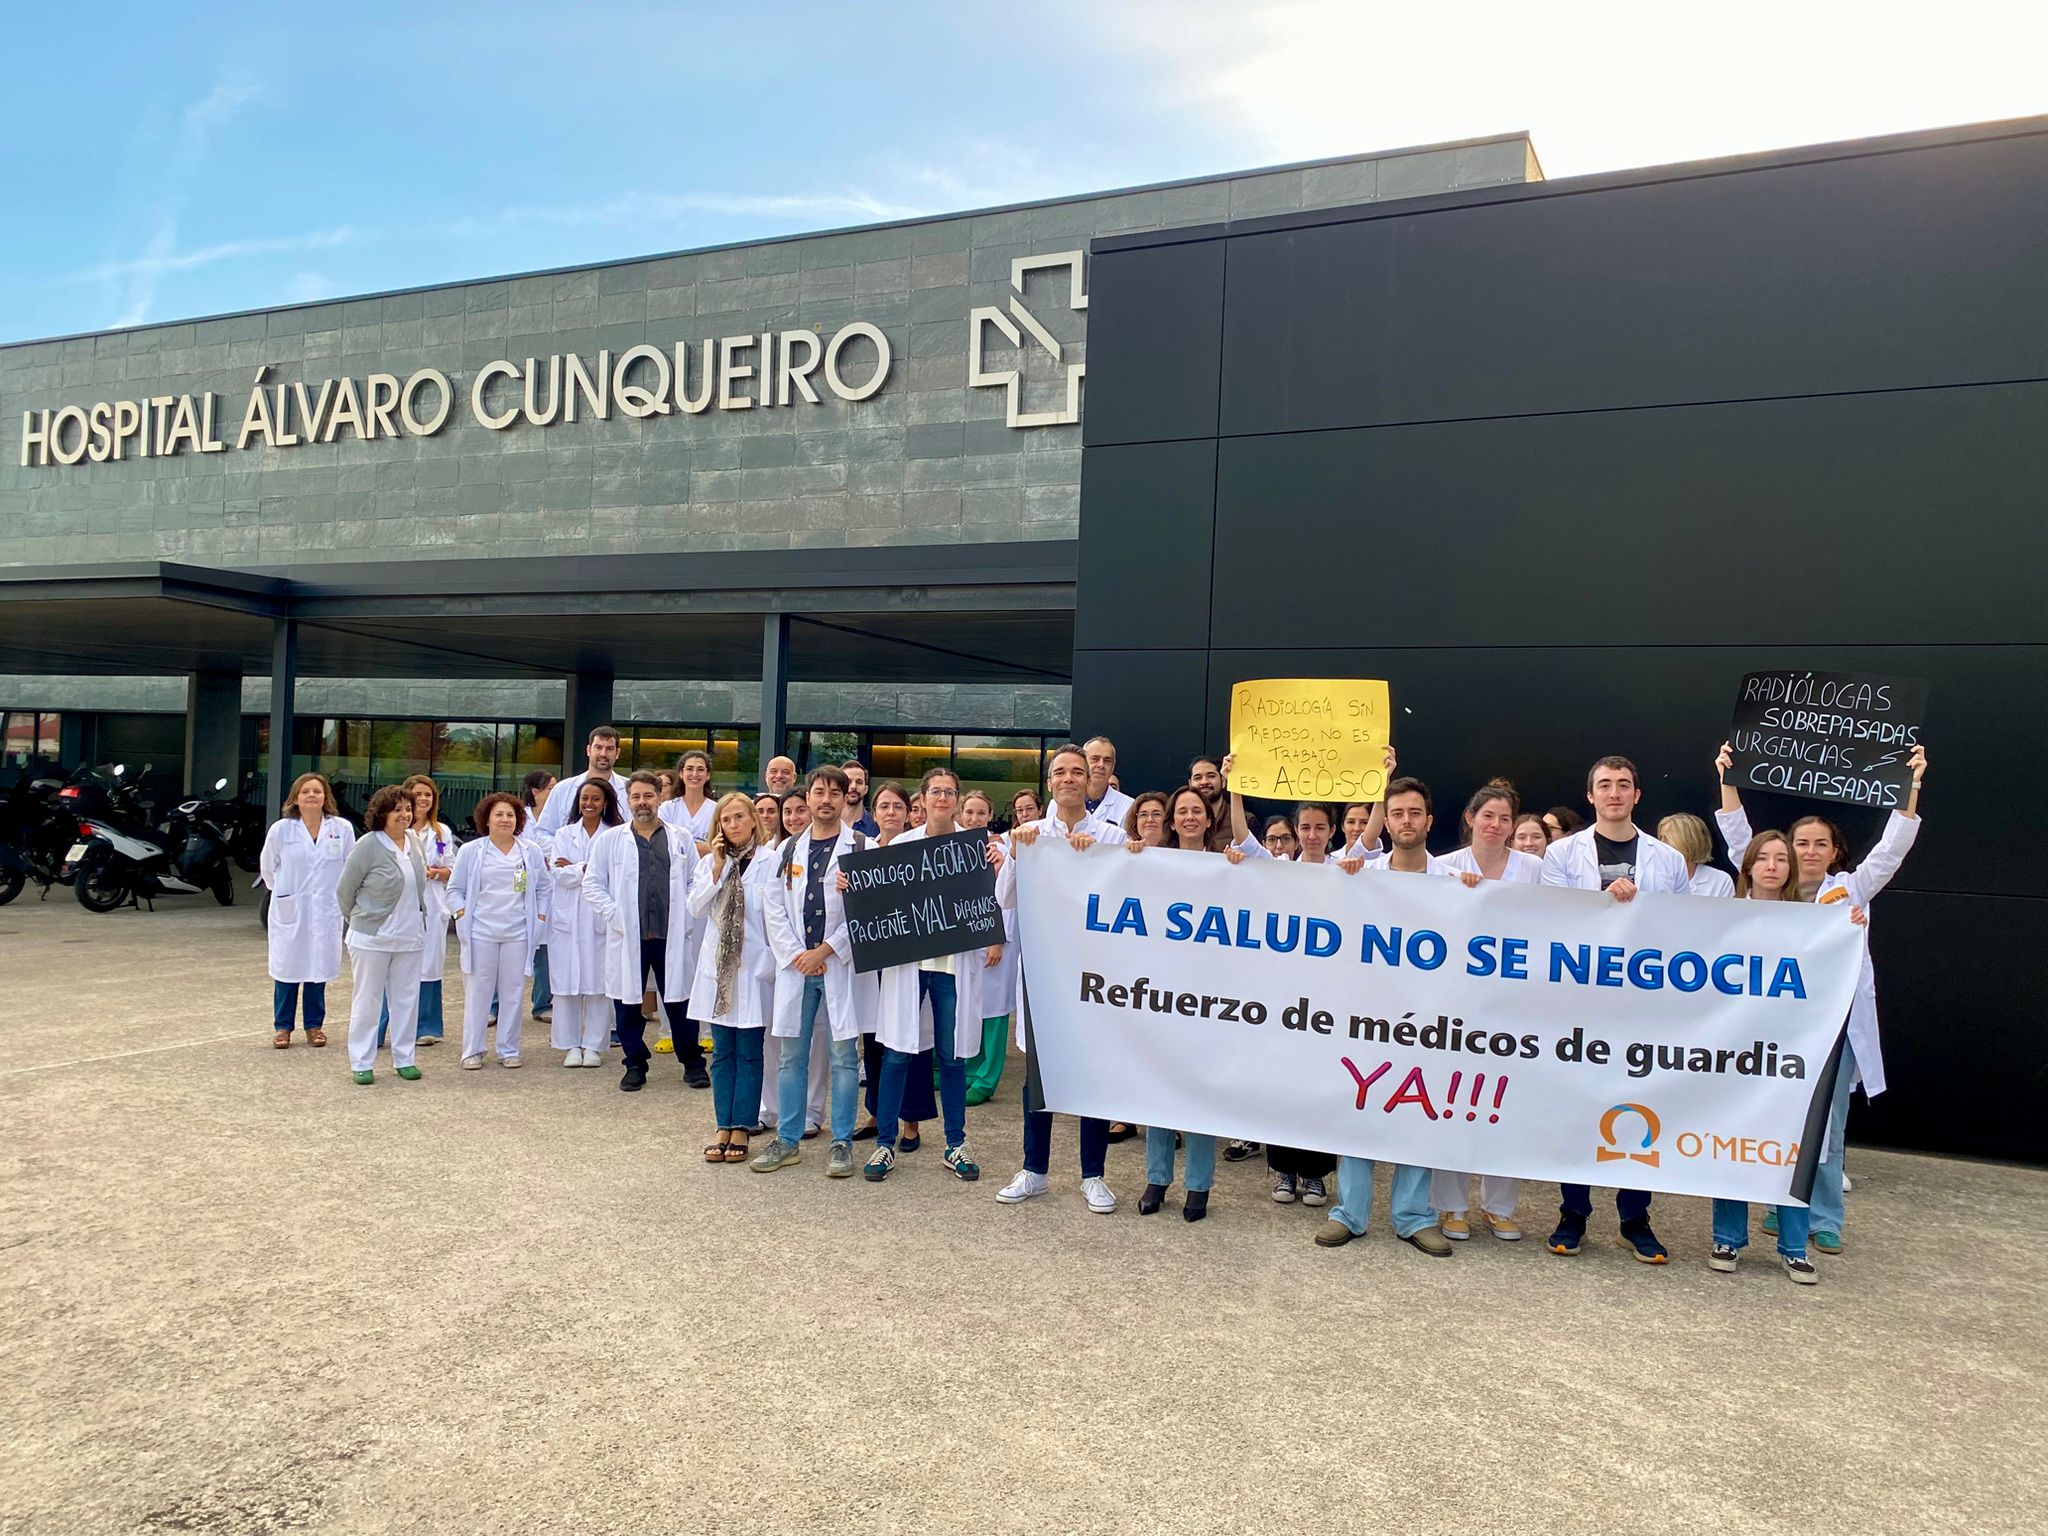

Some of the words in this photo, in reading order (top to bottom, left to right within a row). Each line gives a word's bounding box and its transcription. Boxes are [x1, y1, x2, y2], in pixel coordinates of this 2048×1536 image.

[20, 391, 227, 466] HOSPITAL
[236, 365, 454, 450] ÁLVARO
[471, 321, 892, 430] CUNQUEIRO
[1238, 689, 1334, 720] RADIOLOGÍA
[1348, 699, 1374, 717] SIN
[1744, 672, 1892, 711] RADIÓLOGAS
[1320, 728, 1342, 740] NO
[1352, 728, 1370, 743] ES
[1759, 707, 1919, 747] SOBREPASADAS
[1269, 745, 1342, 767] TRABAJO,
[1735, 729, 1856, 769] URGENCIAS
[1240, 776, 1260, 790] ES
[1750, 762, 1901, 806] COLAPSADAS
[920, 839, 987, 882] AGOTADO
[849, 908, 911, 944] PACIENTE
[911, 895, 957, 936] MAL
[1085, 893, 1148, 937] LA
[1165, 902, 1342, 958] SALUD
[1361, 924, 1448, 971] NO
[1466, 935, 1529, 980] SE
[1549, 941, 1807, 999] NEGOCIA
[1079, 971, 1268, 1025] Refuerzo
[1281, 997, 1334, 1034] de
[1349, 1012, 1540, 1059] médicos
[1555, 1027, 1611, 1065] de
[1625, 1040, 1806, 1079] guardia
[1341, 1056, 1508, 1124] YA!!!
